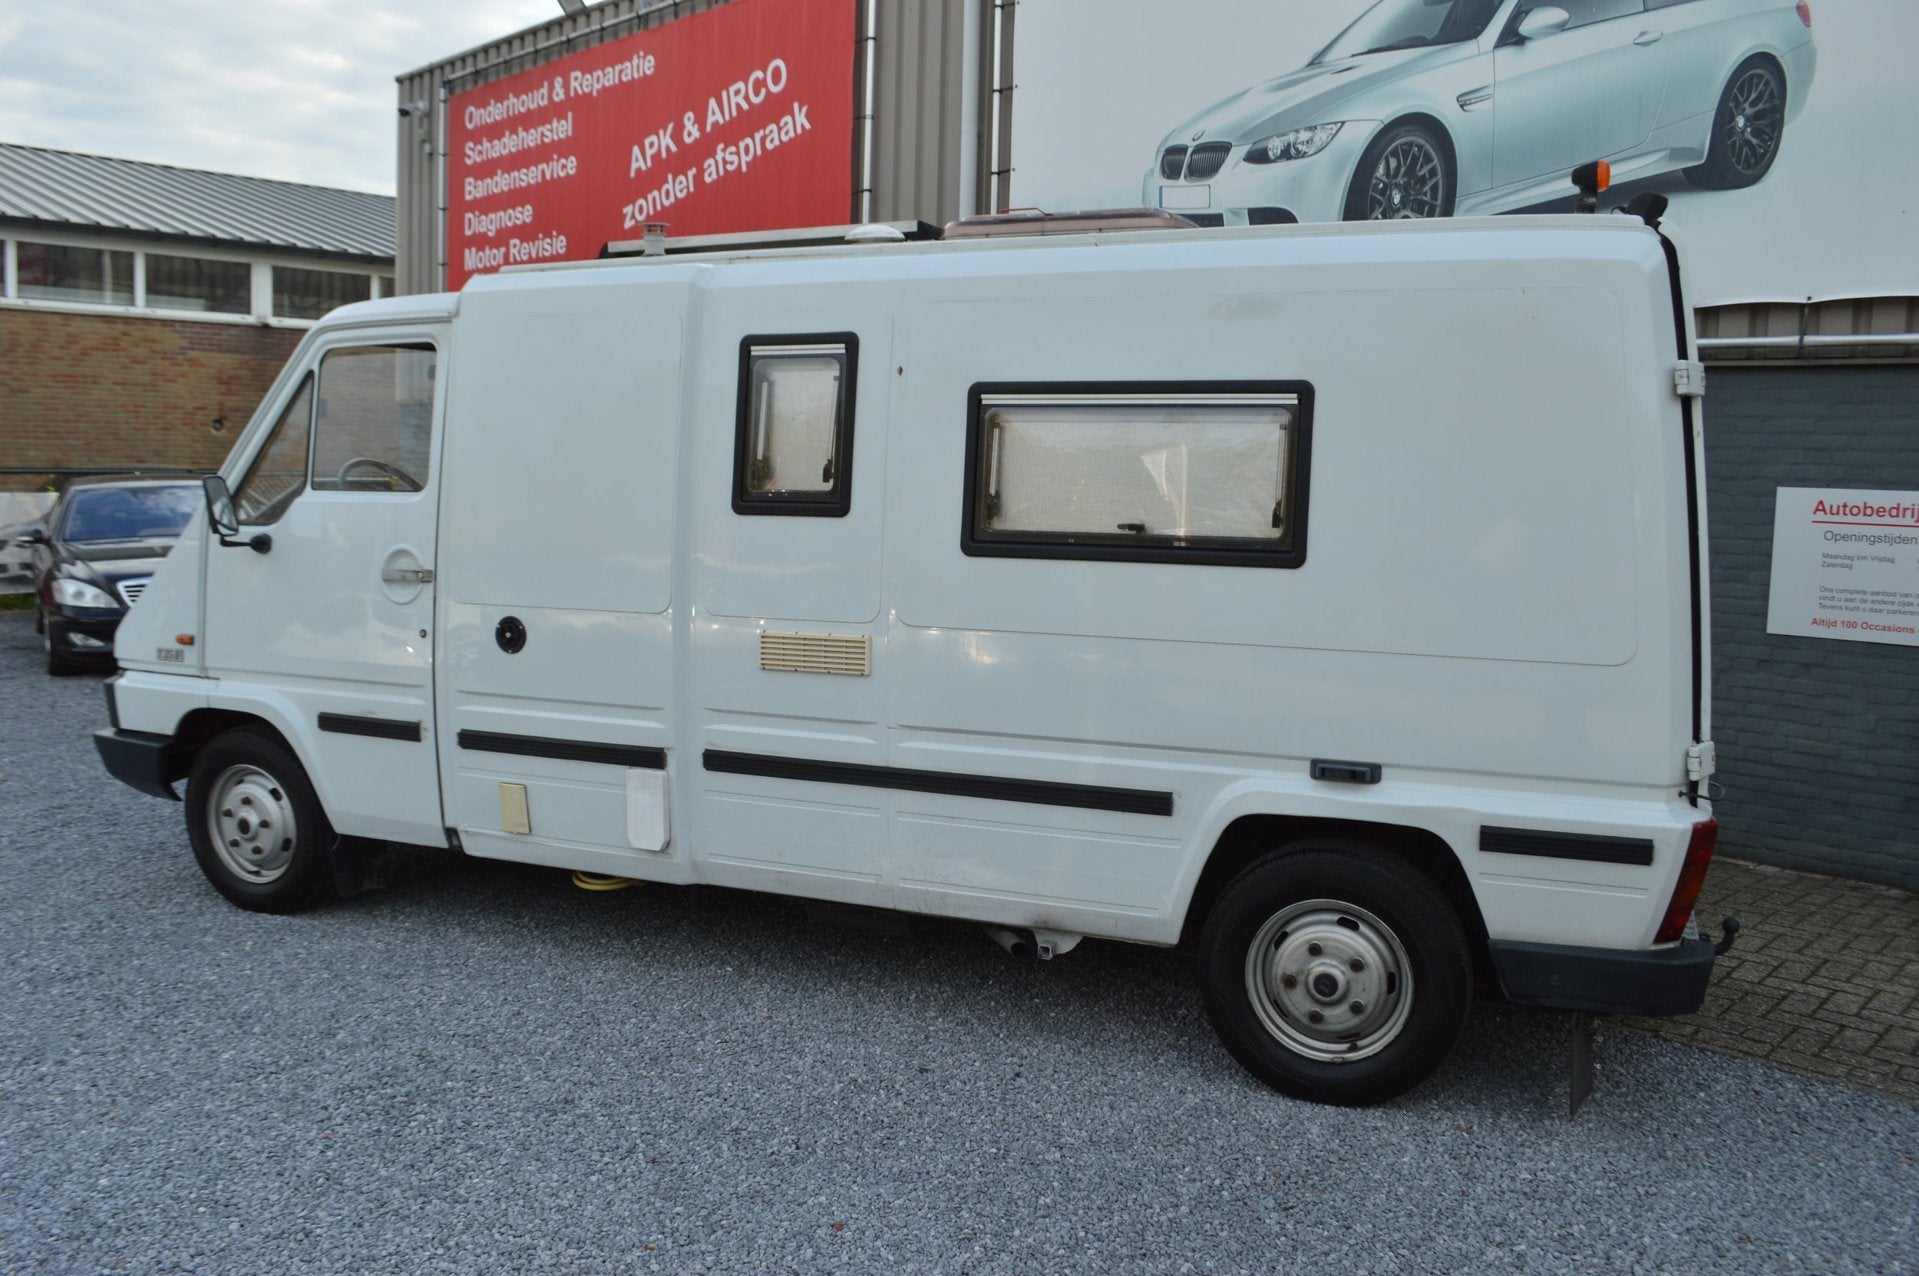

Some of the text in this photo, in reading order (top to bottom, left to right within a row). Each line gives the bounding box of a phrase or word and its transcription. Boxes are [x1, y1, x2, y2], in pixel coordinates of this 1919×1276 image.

[464, 50, 656, 130] Onderhoud & Reparatie
[630, 58, 788, 178] APK & AIRCO
[464, 111, 574, 166] Schadeherstel
[464, 152, 578, 201] Bandenservice
[622, 101, 812, 230] zonder afspraak
[464, 203, 534, 236] Diagnose
[464, 231, 567, 271] Motor Revisie
[1824, 530, 1918, 546] Openingstijden
[1820, 561, 1853, 571] Zaterdag
[1821, 553, 1855, 562] Maandag
[1871, 555, 1895, 564] Vrijdag
[1819, 586, 1834, 594] Ons
[1835, 587, 1868, 597] complete
[1869, 589, 1897, 598] aanbod
[1869, 598, 1895, 606] andere
[1818, 603, 1843, 611] Tevens
[1811, 617, 1915, 634] Altijd 100 Occasions
